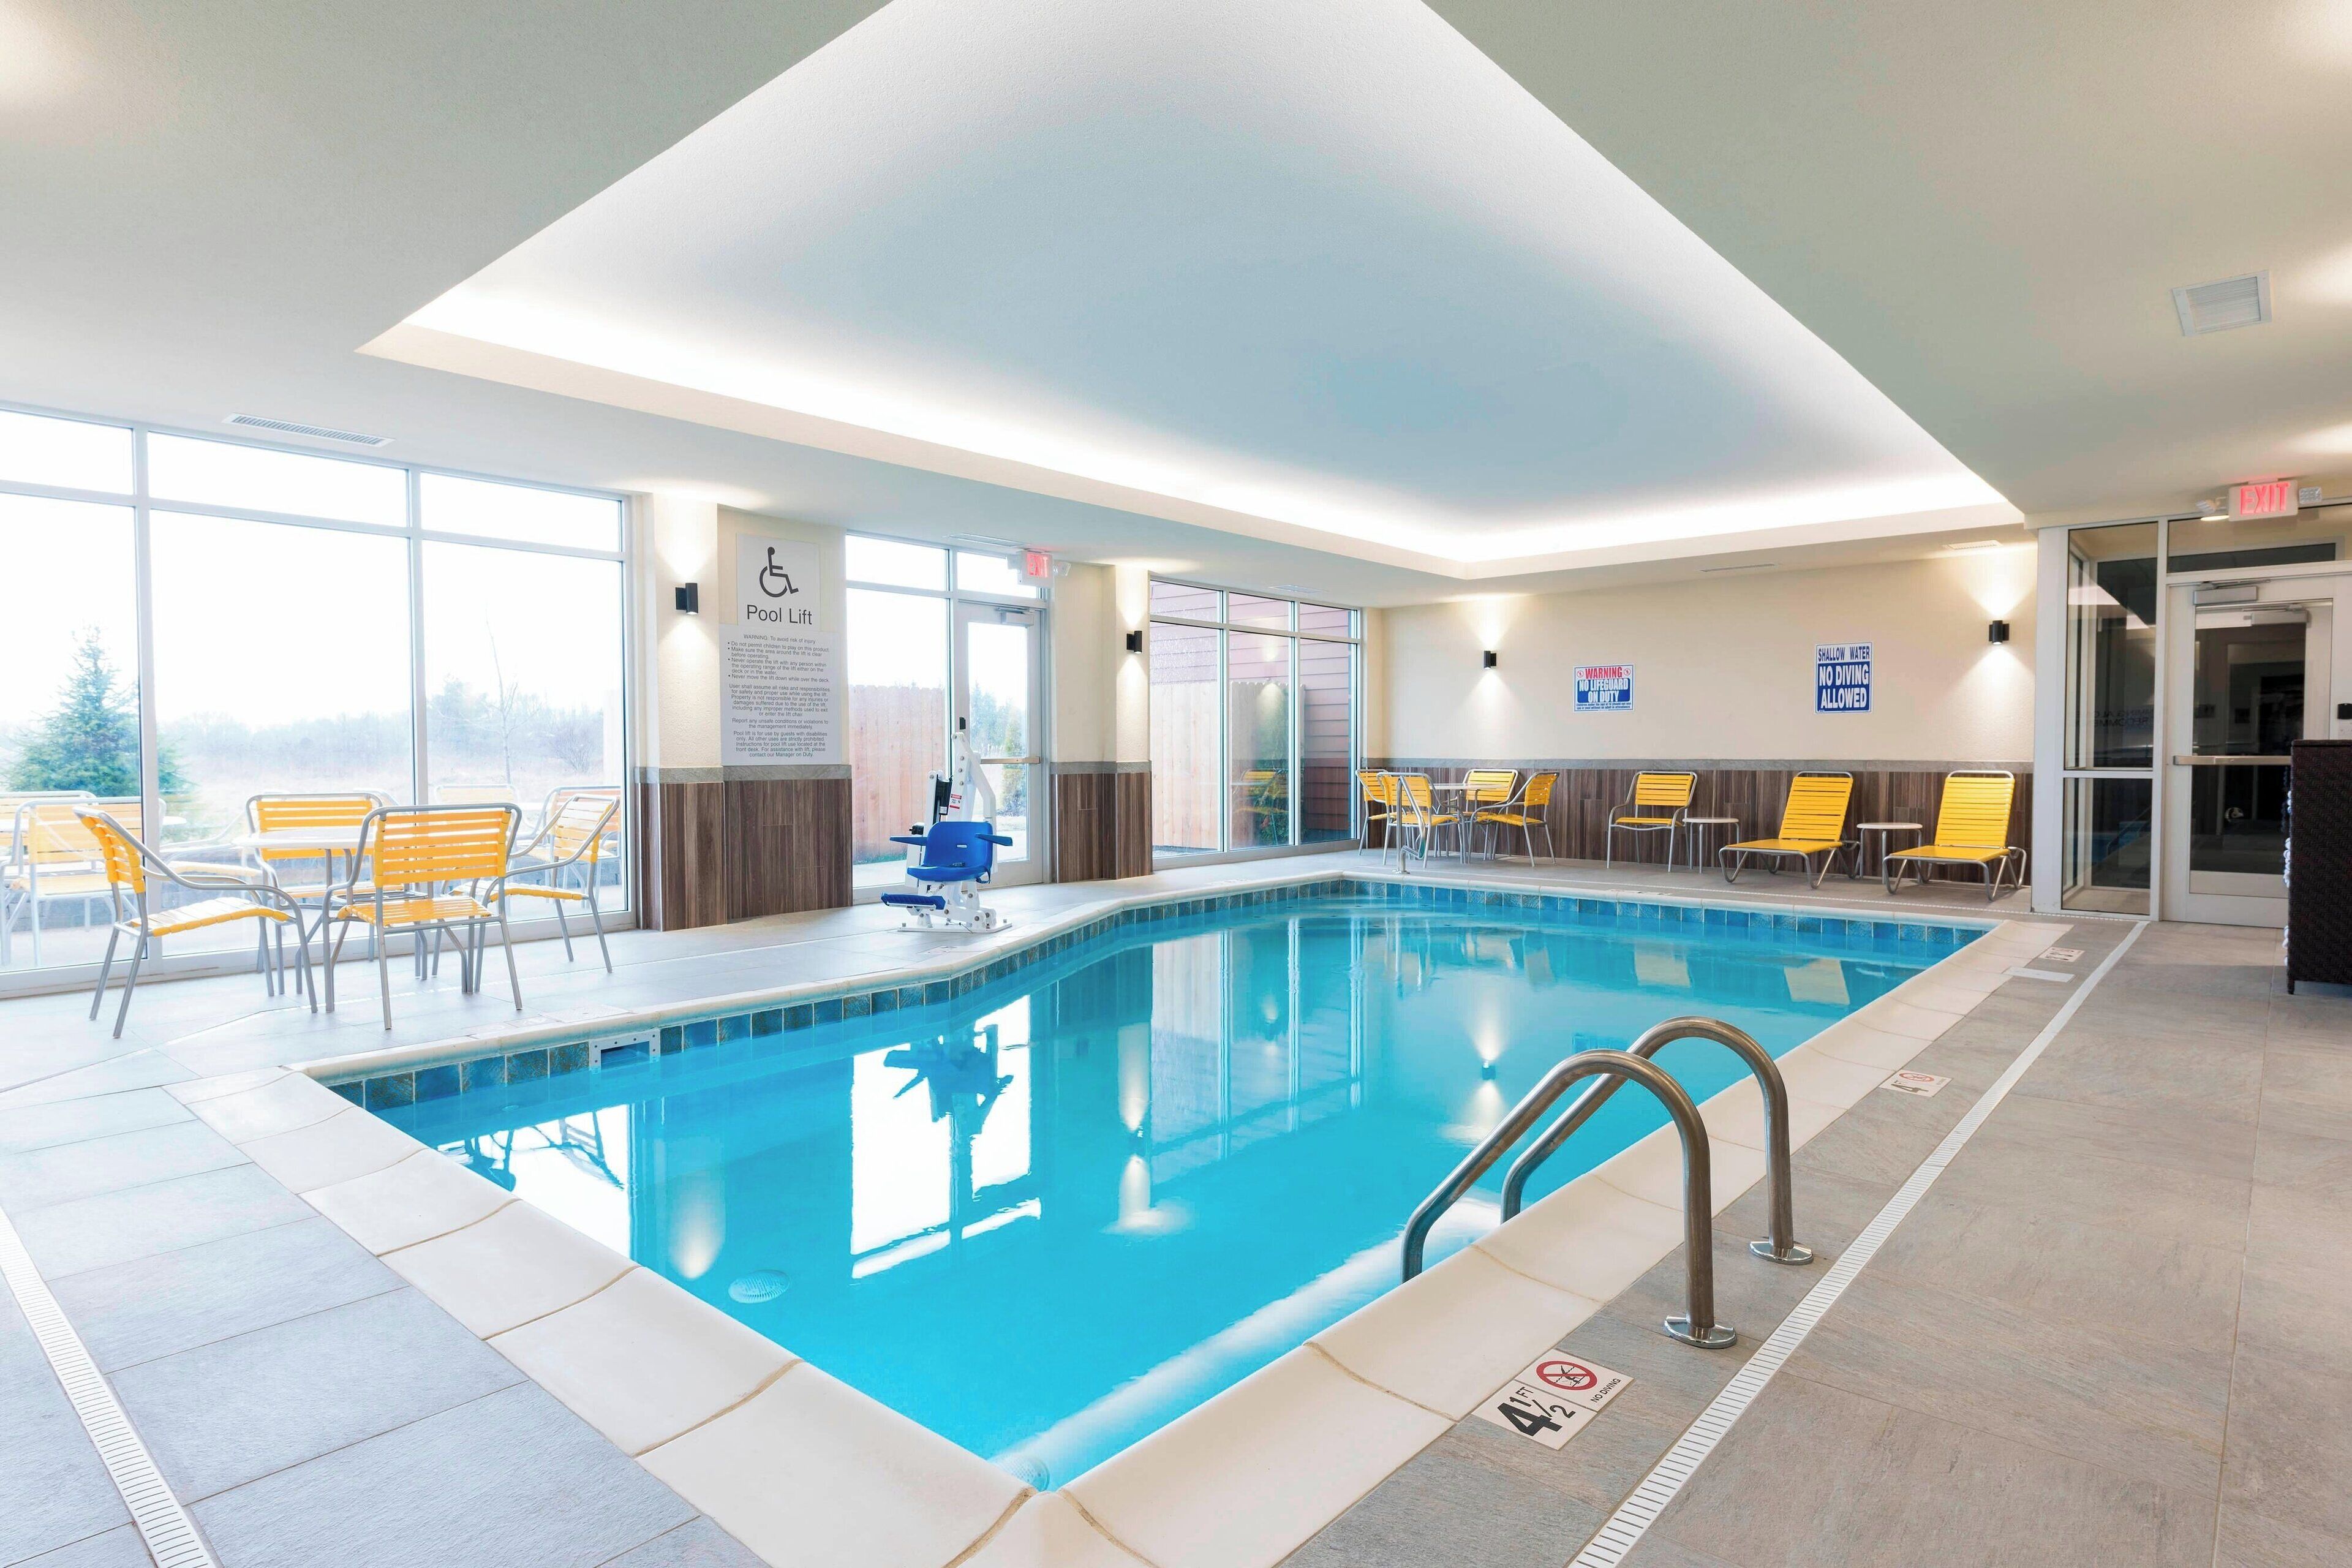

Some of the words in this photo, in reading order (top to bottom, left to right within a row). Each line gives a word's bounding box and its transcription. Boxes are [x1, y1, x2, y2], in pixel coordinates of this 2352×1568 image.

[2240, 483, 2290, 515] EXIT
[747, 605, 782, 622] Pool
[790, 608, 812, 625] Lift
[1819, 647, 1845, 662] SHALLOW
[1850, 646, 1870, 660] WATER
[1585, 666, 1622, 679] WARNING
[1819, 666, 1833, 686] NO
[1836, 664, 1869, 686] DIVING
[1579, 680, 1589, 692] NO
[1591, 679, 1628, 691] LIFEGUARD
[1588, 691, 1598, 703] ON
[1600, 690, 1619, 702] DUTY
[1821, 687, 1867, 709] ALLOWED
[1515, 1387, 1534, 1398] FT
[1590, 1393, 1602, 1403] NO
[1600, 1378, 1622, 1395] DIVING
